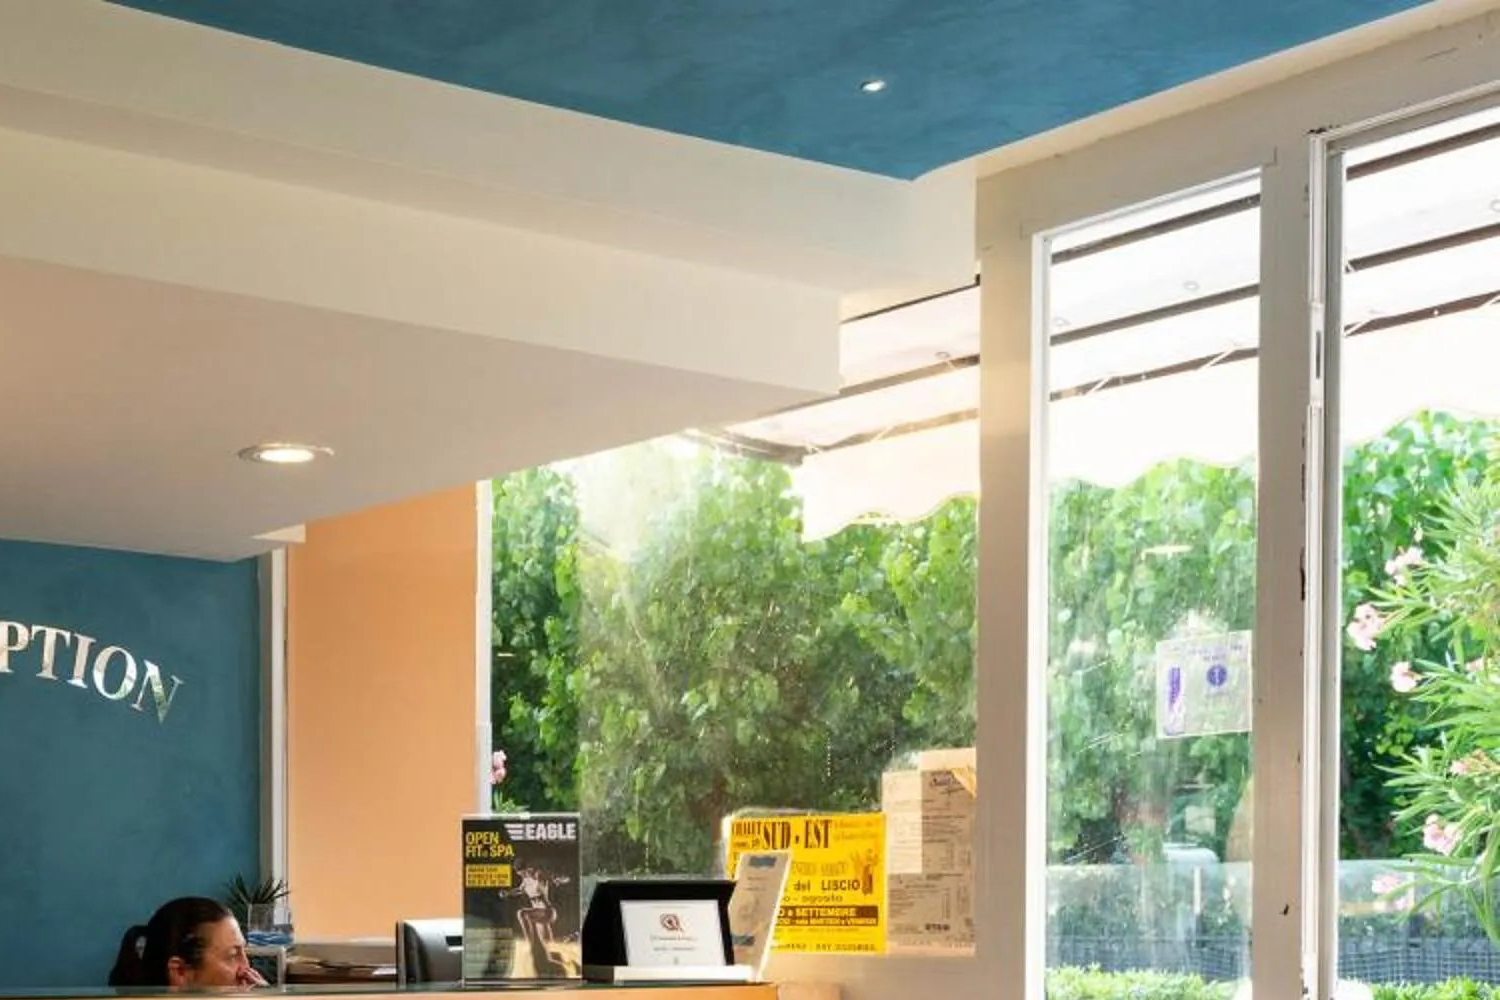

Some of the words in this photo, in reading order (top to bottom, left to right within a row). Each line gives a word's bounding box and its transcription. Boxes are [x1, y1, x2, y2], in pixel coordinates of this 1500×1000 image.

[525, 823, 576, 840] EAGLE
[762, 821, 791, 850] SUD
[804, 819, 832, 849] EST
[465, 832, 500, 845] OPEN
[465, 844, 482, 858] FIT
[489, 844, 514, 857] SPA
[821, 879, 861, 891] LISCIO
[801, 893, 843, 904] agosto
[795, 907, 857, 917] SETTEMBRE
